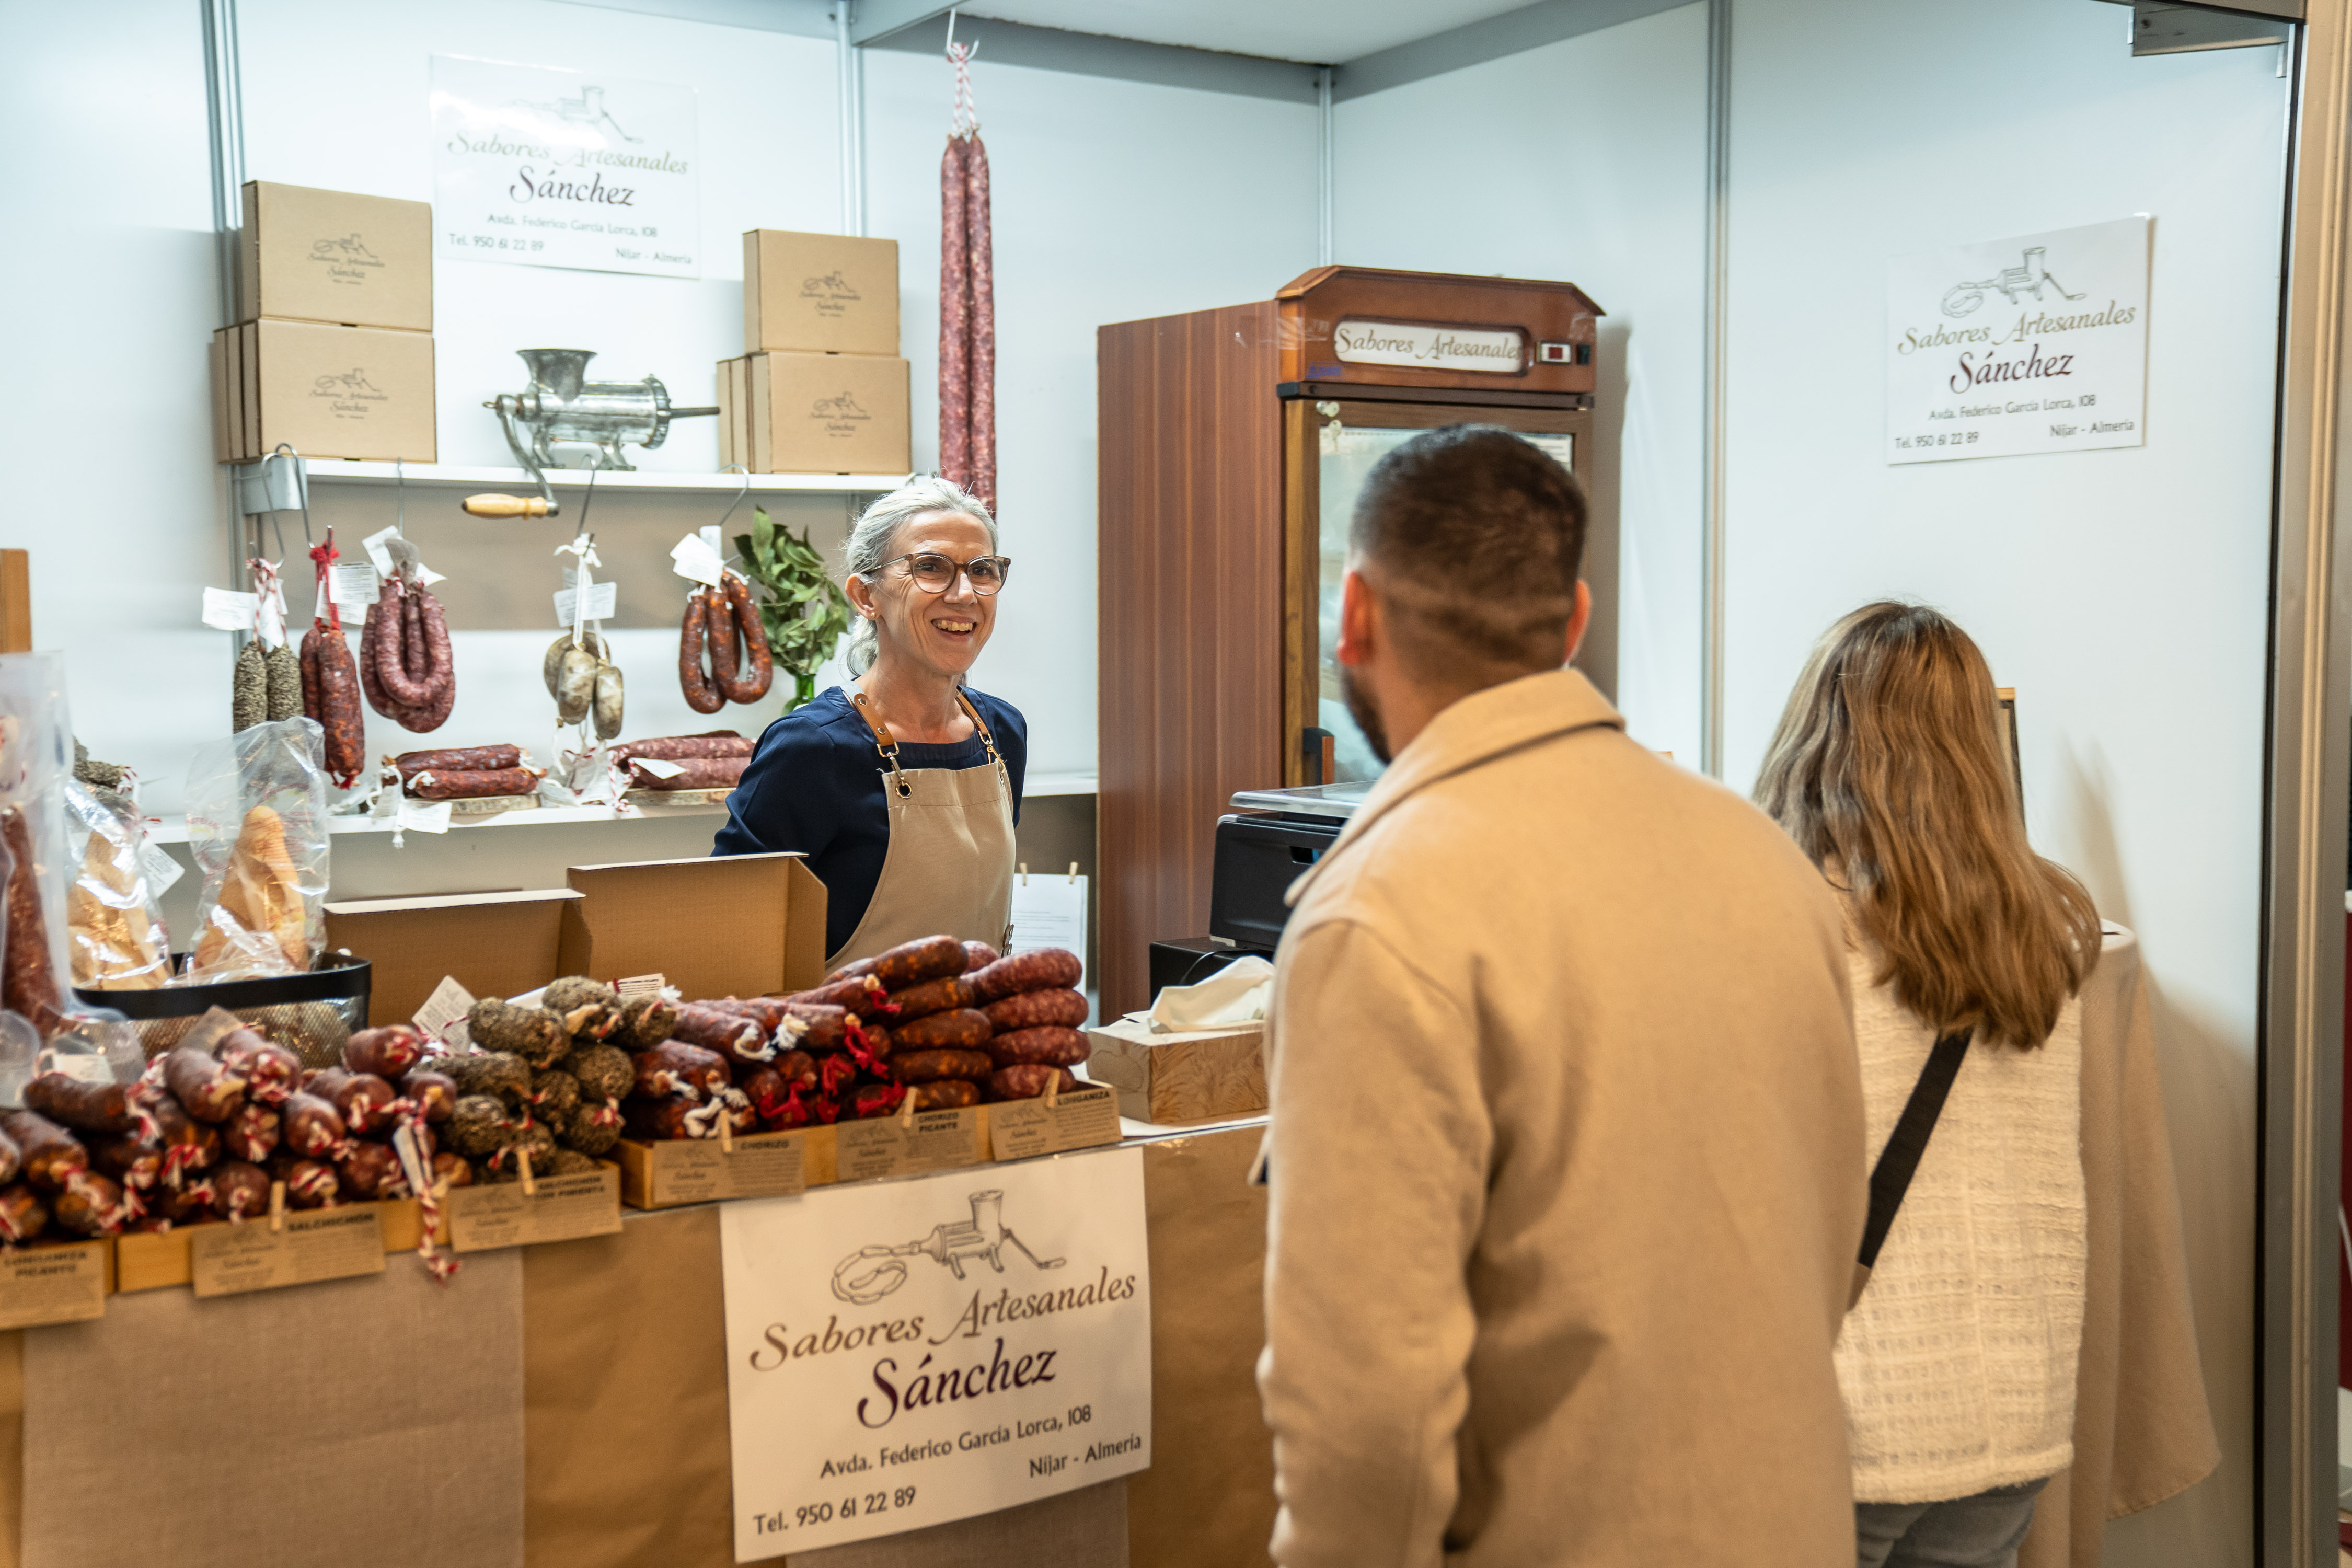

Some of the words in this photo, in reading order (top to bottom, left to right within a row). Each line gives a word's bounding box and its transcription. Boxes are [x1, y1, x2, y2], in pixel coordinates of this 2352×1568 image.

[448, 130, 551, 160] Sabores
[553, 148, 689, 175] Artesanales
[509, 165, 636, 207] Sánchez
[473, 235, 494, 248] 950
[513, 239, 526, 251] 22
[523, 215, 568, 230] Federico
[1334, 328, 1414, 354] Sabores
[1897, 324, 1992, 356] Sabores
[1991, 299, 2137, 345] Artesanales
[1950, 343, 2074, 394] Sánchez
[1960, 405, 2002, 419] Federico
[1915, 435, 1934, 448] 950
[1951, 432, 1962, 445] 22
[1057, 1091, 1110, 1106] LONGANIZA
[919, 1122, 958, 1133] PICANTE
[749, 1315, 924, 1371] Sabores
[928, 1265, 1136, 1346] Artesanales
[856, 1336, 1058, 1429] Sánchez
[820, 1453, 873, 1479] Avda.
[880, 1439, 952, 1467] Federico
[1017, 1415, 1063, 1439] Lorca,
[1068, 1404, 1092, 1426] 108
[753, 1511, 789, 1535] Tel.
[796, 1502, 833, 1527] 950
[840, 1497, 857, 1519] 61
[864, 1491, 887, 1515] 22
[894, 1485, 916, 1508] 89
